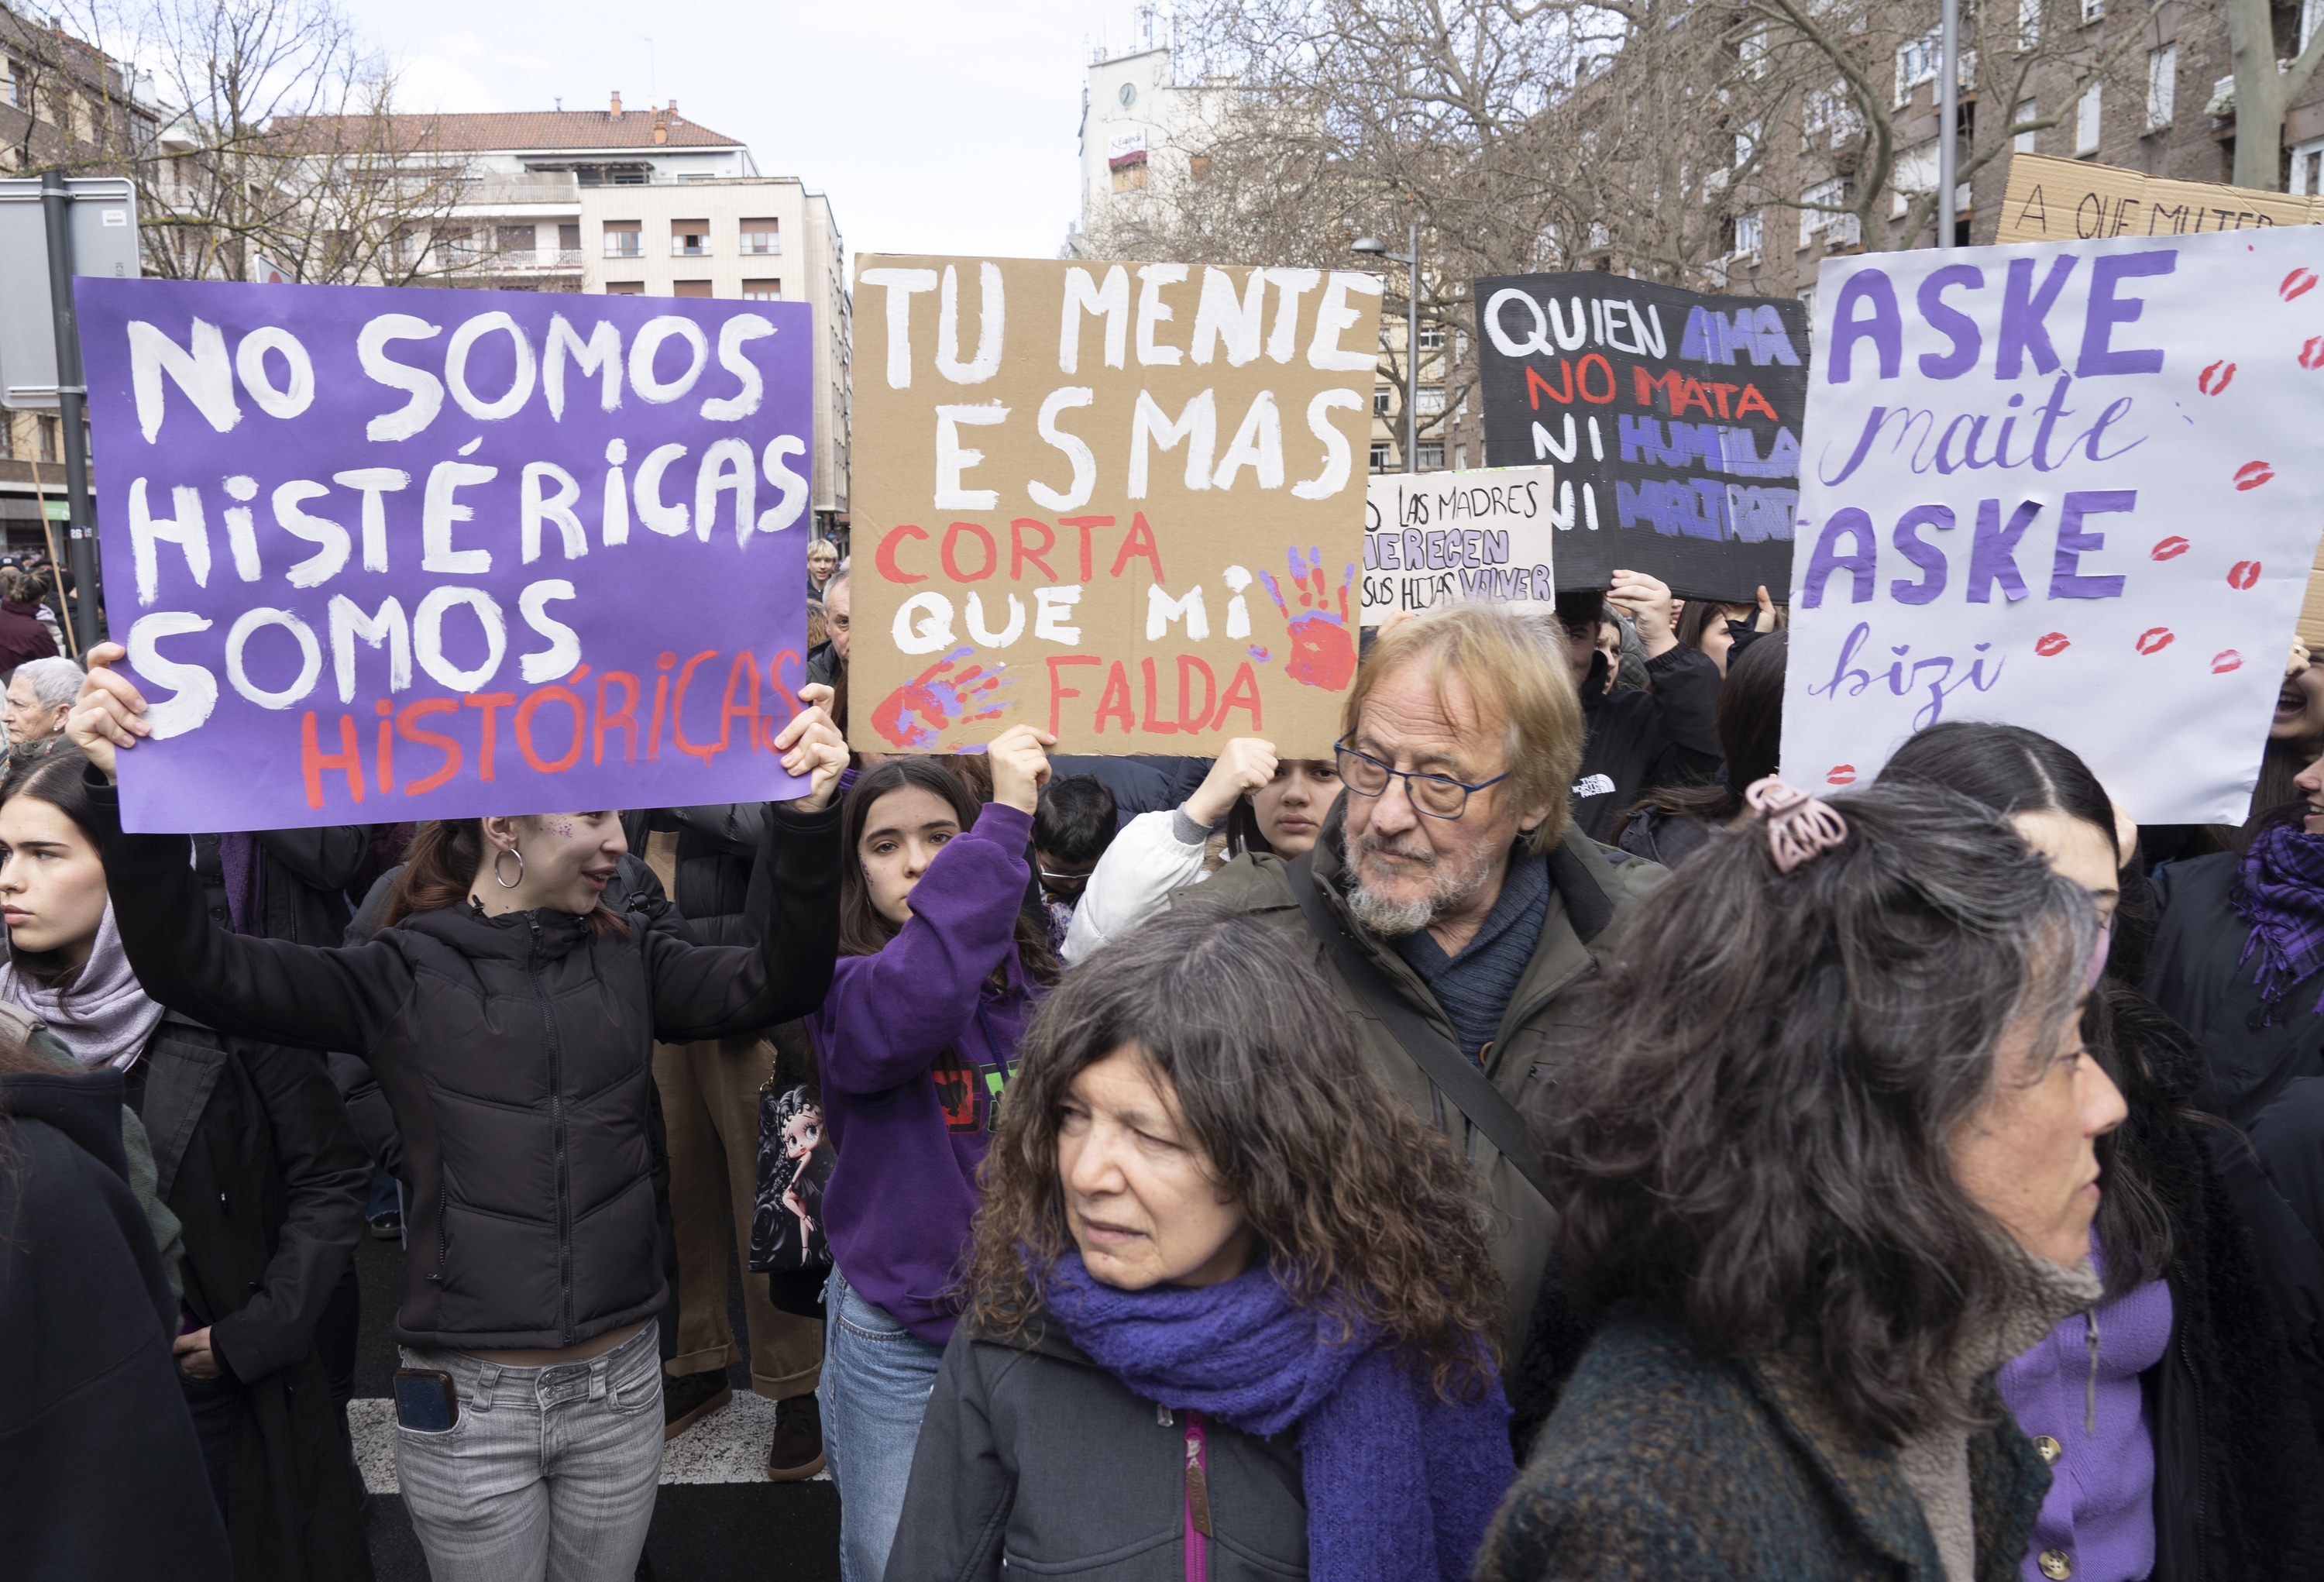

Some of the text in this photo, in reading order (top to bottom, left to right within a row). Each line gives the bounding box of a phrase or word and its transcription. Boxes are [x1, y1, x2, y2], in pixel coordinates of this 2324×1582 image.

[2014, 184, 2047, 234] A
[2075, 191, 2140, 239] QUE
[859, 260, 1385, 390] TU MENTE
[1483, 287, 1803, 366] QUIEN AMA
[1827, 249, 2179, 386] ASKE
[127, 311, 779, 444] NO SOMOS
[1525, 353, 1780, 422] NO MATA
[933, 386, 1365, 512] ES MAS
[1531, 412, 1605, 464] NI
[1818, 369, 2149, 487] maite
[1398, 484, 1429, 528] LAS
[1439, 480, 1539, 521] MADRES
[1614, 477, 1799, 544] MALTRAT
[875, 511, 1167, 584] CORTA
[1801, 489, 2139, 609] ASKE
[890, 584, 1085, 655] QUE
[1361, 576, 1394, 608] SUS
[1458, 564, 1552, 604] VOLVER
[126, 578, 581, 740] SOMOS
[1046, 654, 1263, 737] FALDA
[1807, 621, 2008, 734] bizi
[1571, 782, 1600, 793] NORTH
[1580, 775, 1598, 785] THE
[1580, 787, 1602, 798] FACE
